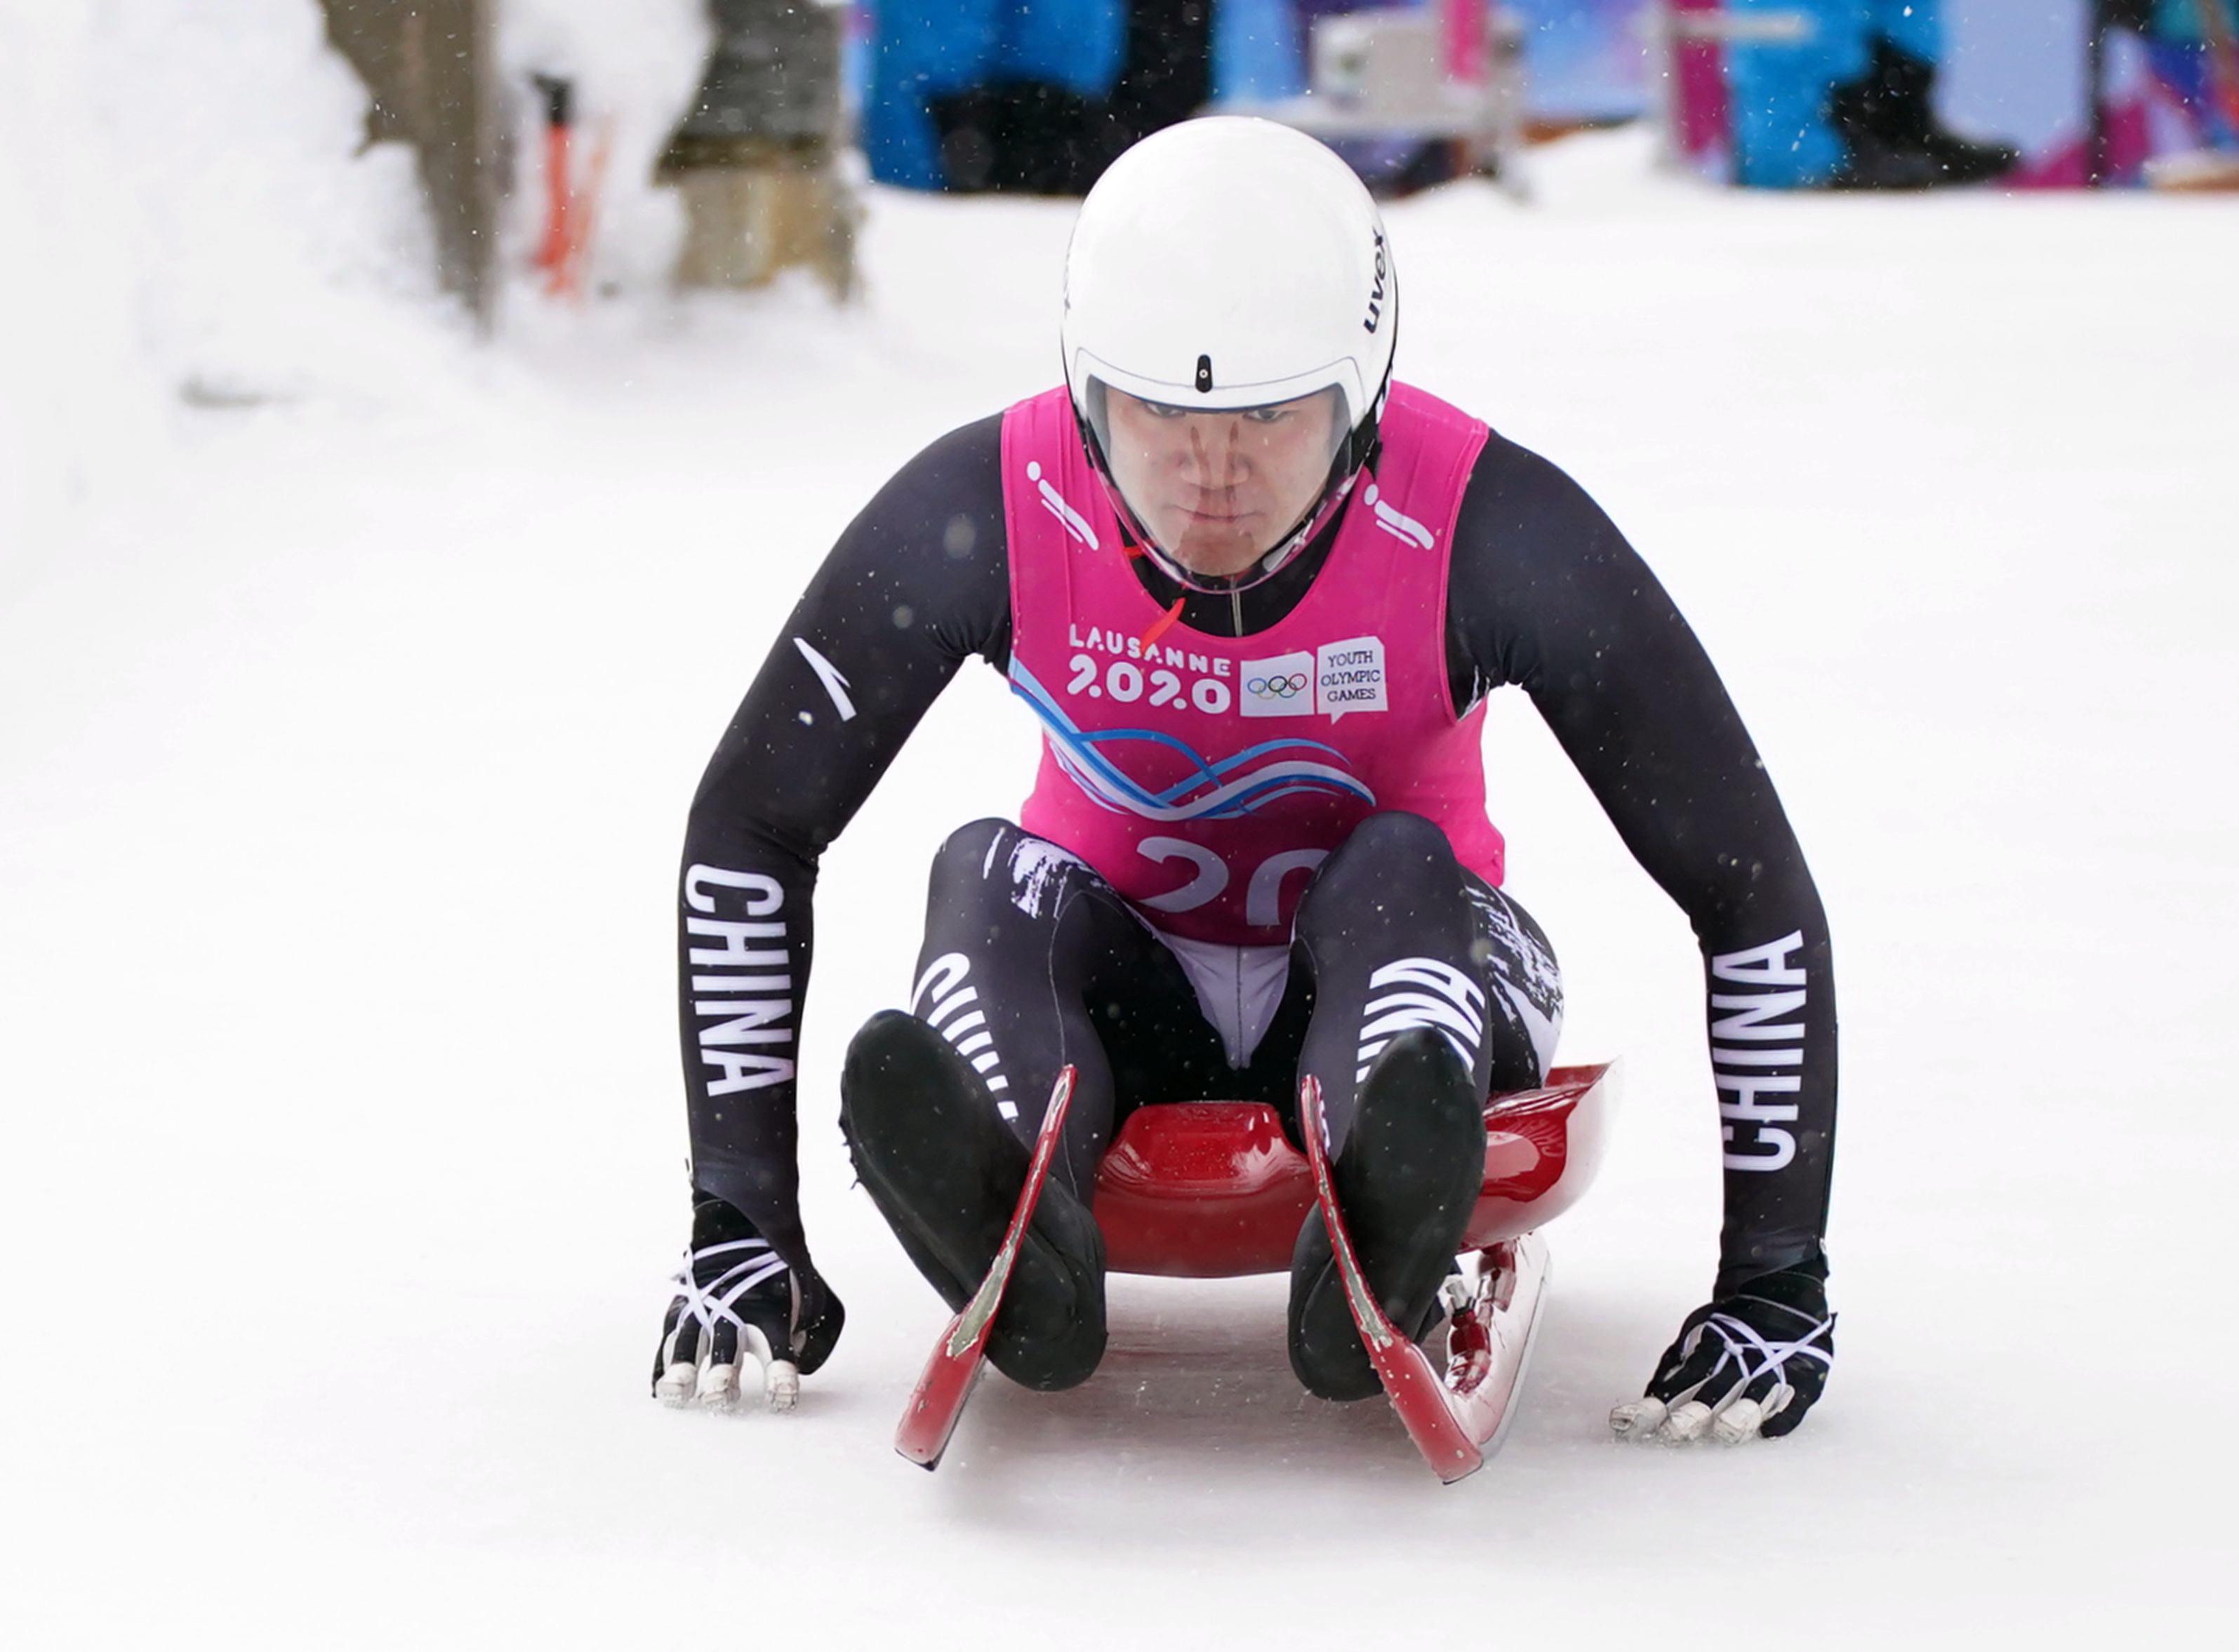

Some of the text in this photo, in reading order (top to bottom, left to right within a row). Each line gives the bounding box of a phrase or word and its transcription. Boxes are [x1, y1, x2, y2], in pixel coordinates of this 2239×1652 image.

[1363, 225, 1386, 334] uvex
[1069, 623, 1231, 677] LAUSANNE
[1320, 670, 1381, 686] OLYMPIC
[1328, 650, 1374, 667] YOUTH
[1066, 653, 1231, 714] 2020
[1327, 688, 1376, 702] GAMES
[685, 863, 795, 1097] CHINA
[1711, 929, 1807, 1172] CHINA
